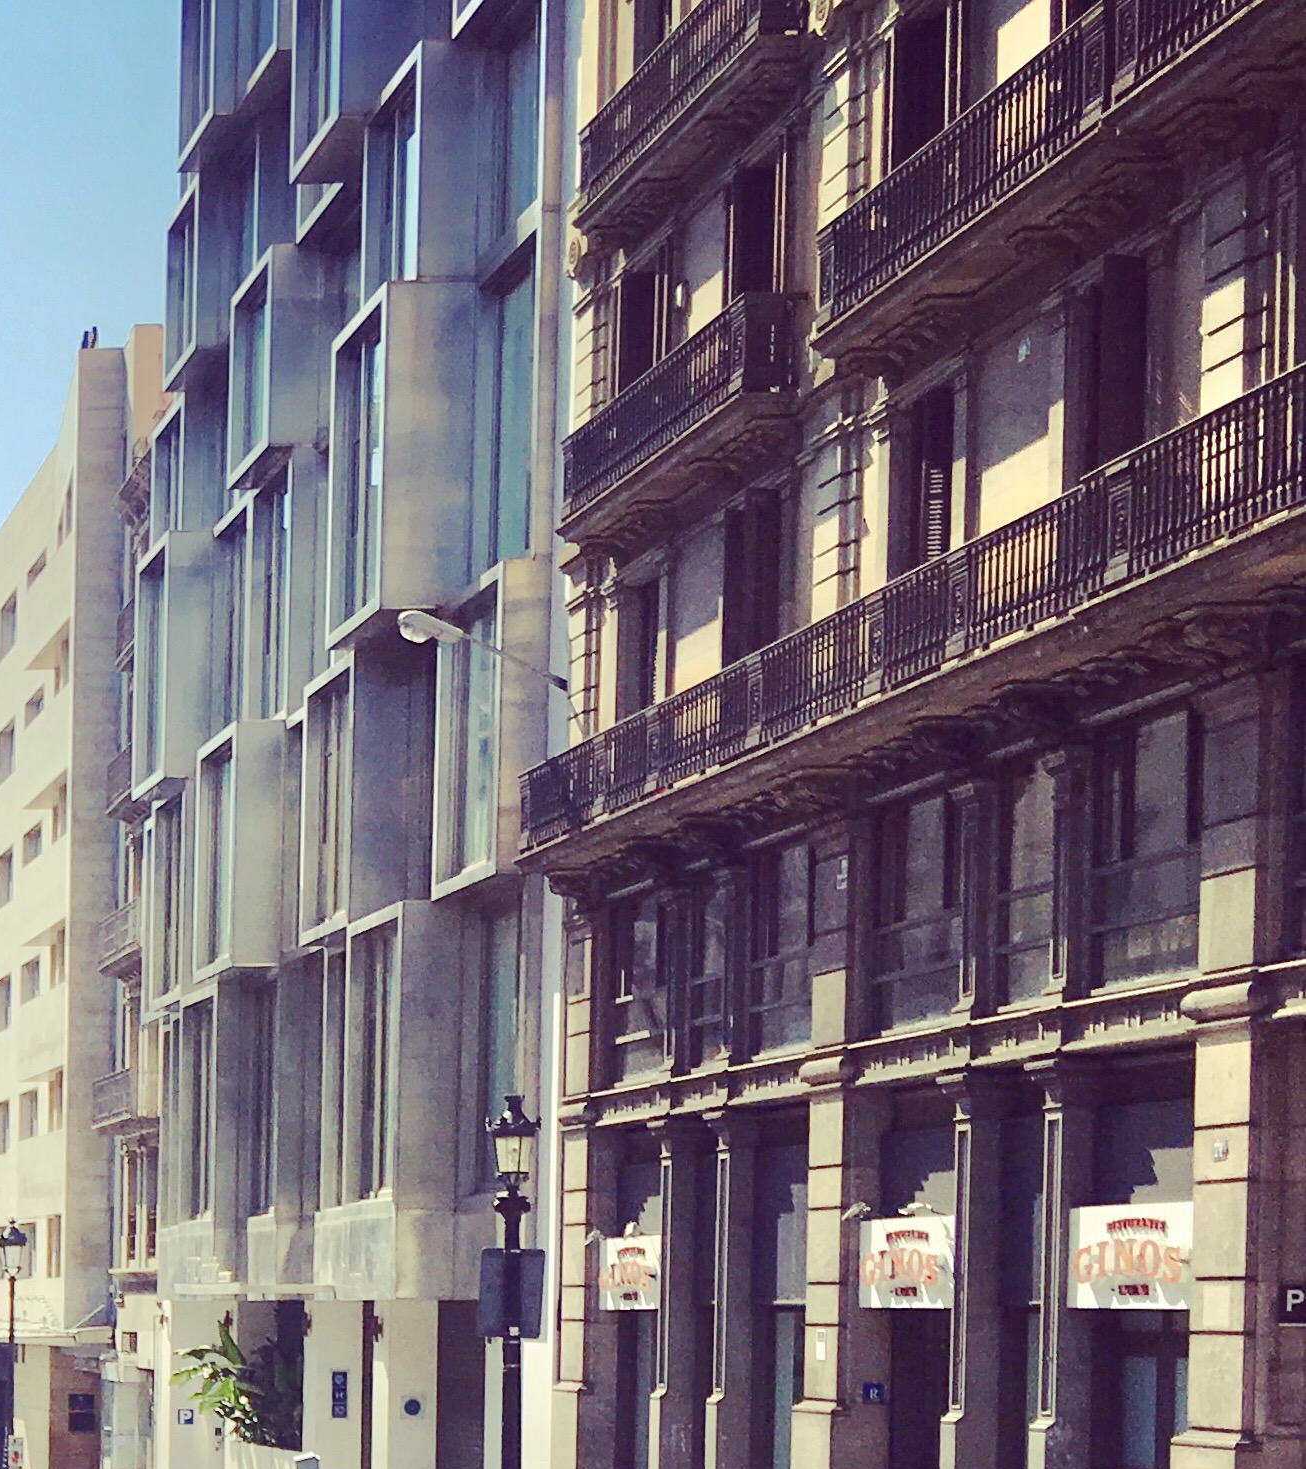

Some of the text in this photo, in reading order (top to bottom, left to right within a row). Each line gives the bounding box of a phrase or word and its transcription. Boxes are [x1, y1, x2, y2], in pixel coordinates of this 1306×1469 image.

[860, 1248, 939, 1288] GINOS
[1073, 1238, 1182, 1285] GINOS
[179, 1409, 193, 1425] P
